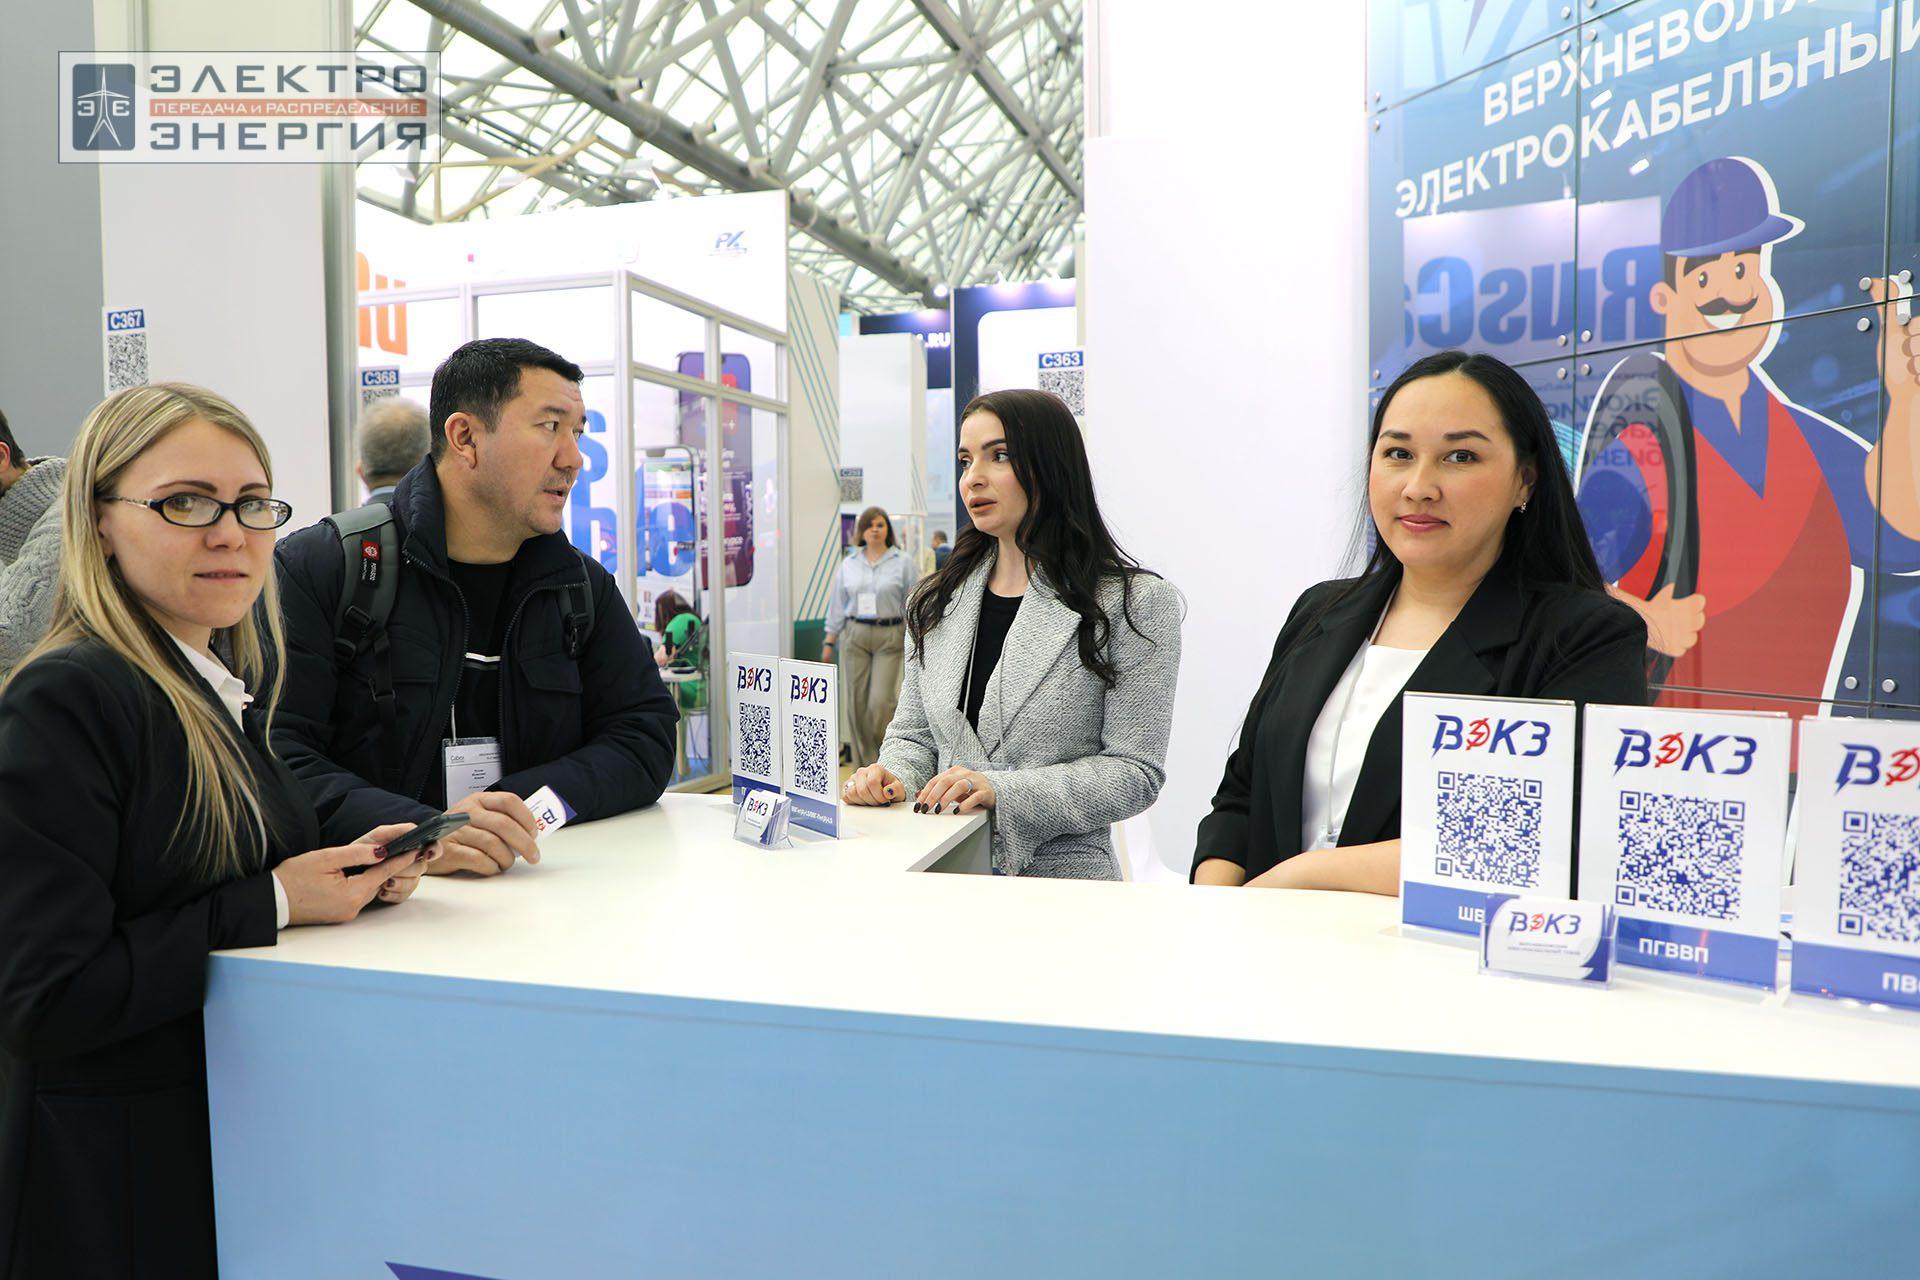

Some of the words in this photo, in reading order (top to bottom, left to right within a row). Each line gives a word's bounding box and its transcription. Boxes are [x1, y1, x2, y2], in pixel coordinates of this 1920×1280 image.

[1484, 0, 1818, 126] ВЕРХНЕВОЛ
[1458, 905, 1486, 923] ШВ
[1638, 936, 1709, 965] ПГВВП
[1882, 972, 1920, 993] ПВ
